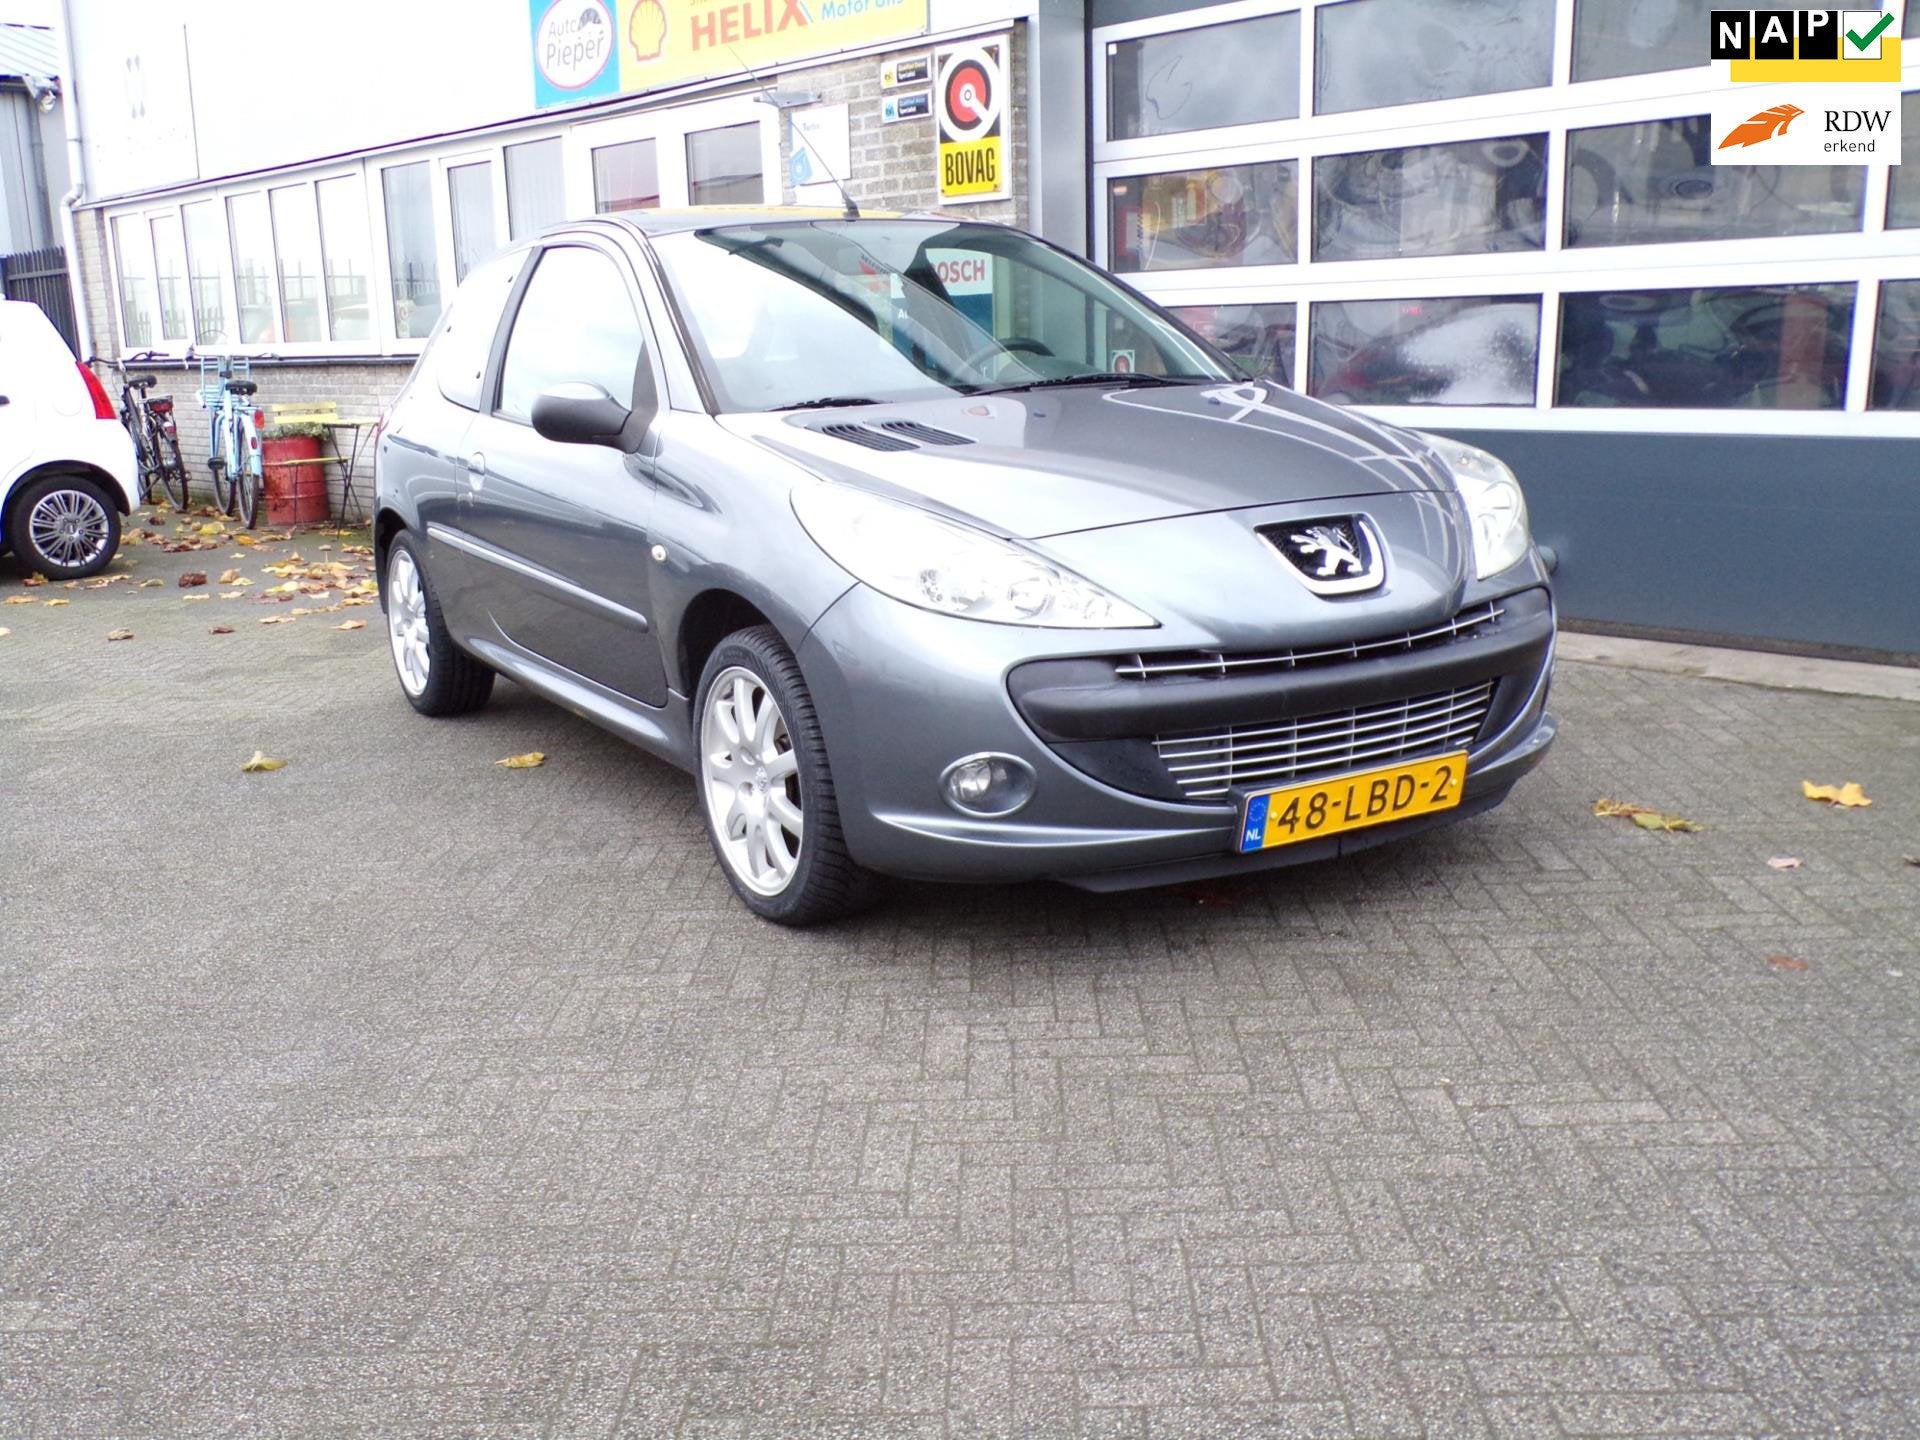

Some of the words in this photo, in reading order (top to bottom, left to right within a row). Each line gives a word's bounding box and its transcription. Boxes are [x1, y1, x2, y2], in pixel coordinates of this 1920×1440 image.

[691, 0, 809, 51] HELIX
[822, 0, 869, 20] Motor
[546, 37, 603, 71] Pieper
[945, 147, 995, 186] BOVAG
[935, 259, 985, 283] OSCH
[1278, 765, 1452, 834] 48-LBD-2
[1246, 829, 1262, 842] NL
